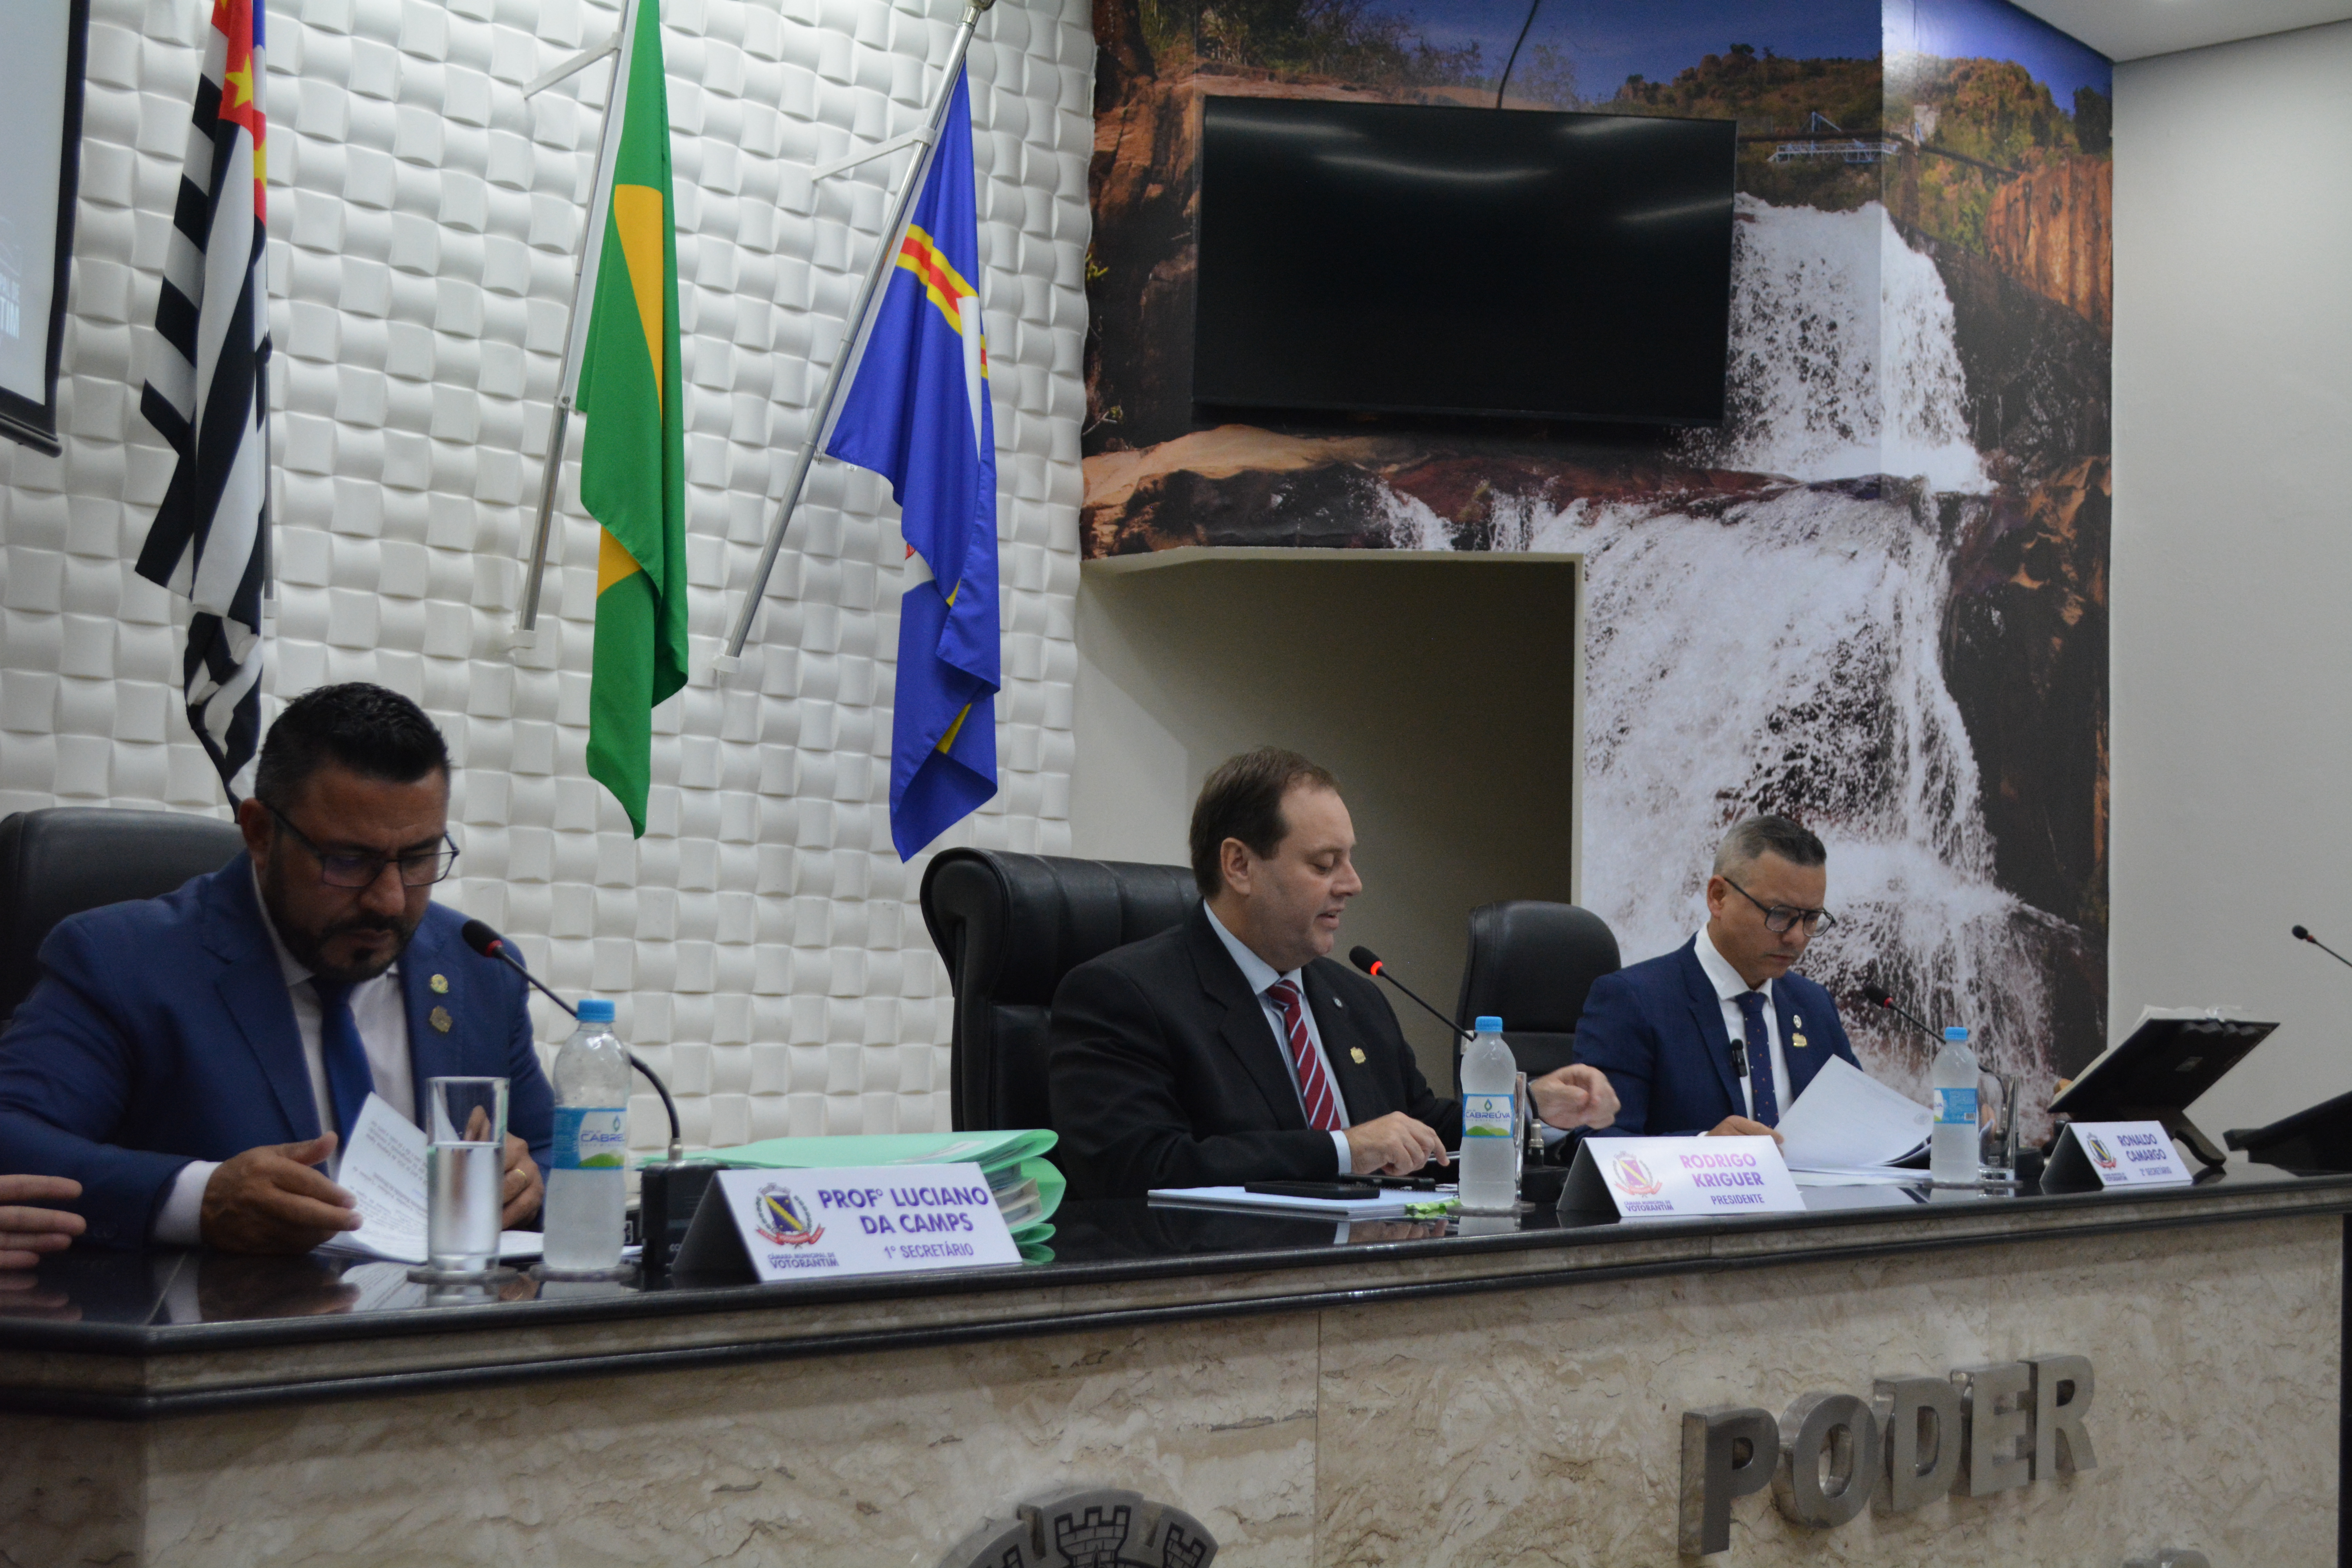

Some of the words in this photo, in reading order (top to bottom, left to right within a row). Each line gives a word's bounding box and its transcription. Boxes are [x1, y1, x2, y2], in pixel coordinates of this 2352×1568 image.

[580, 1133, 625, 1142] CABRE
[2117, 1134, 2158, 1146] RONALDO
[1679, 1153, 1757, 1169] RODRIGO
[2126, 1149, 2167, 1161] CAMARGO
[1691, 1172, 1765, 1187] KRIGUER
[889, 1186, 989, 1207] LUCIANO
[1710, 1194, 1765, 1205] PRESIDENTE
[859, 1214, 897, 1234] DA
[899, 1212, 974, 1233] CAMPS
[900, 1241, 974, 1258] SECRETÁRIO
[769, 1258, 840, 1269] VOTORANTIM
[1679, 1354, 2098, 1556] PODER
